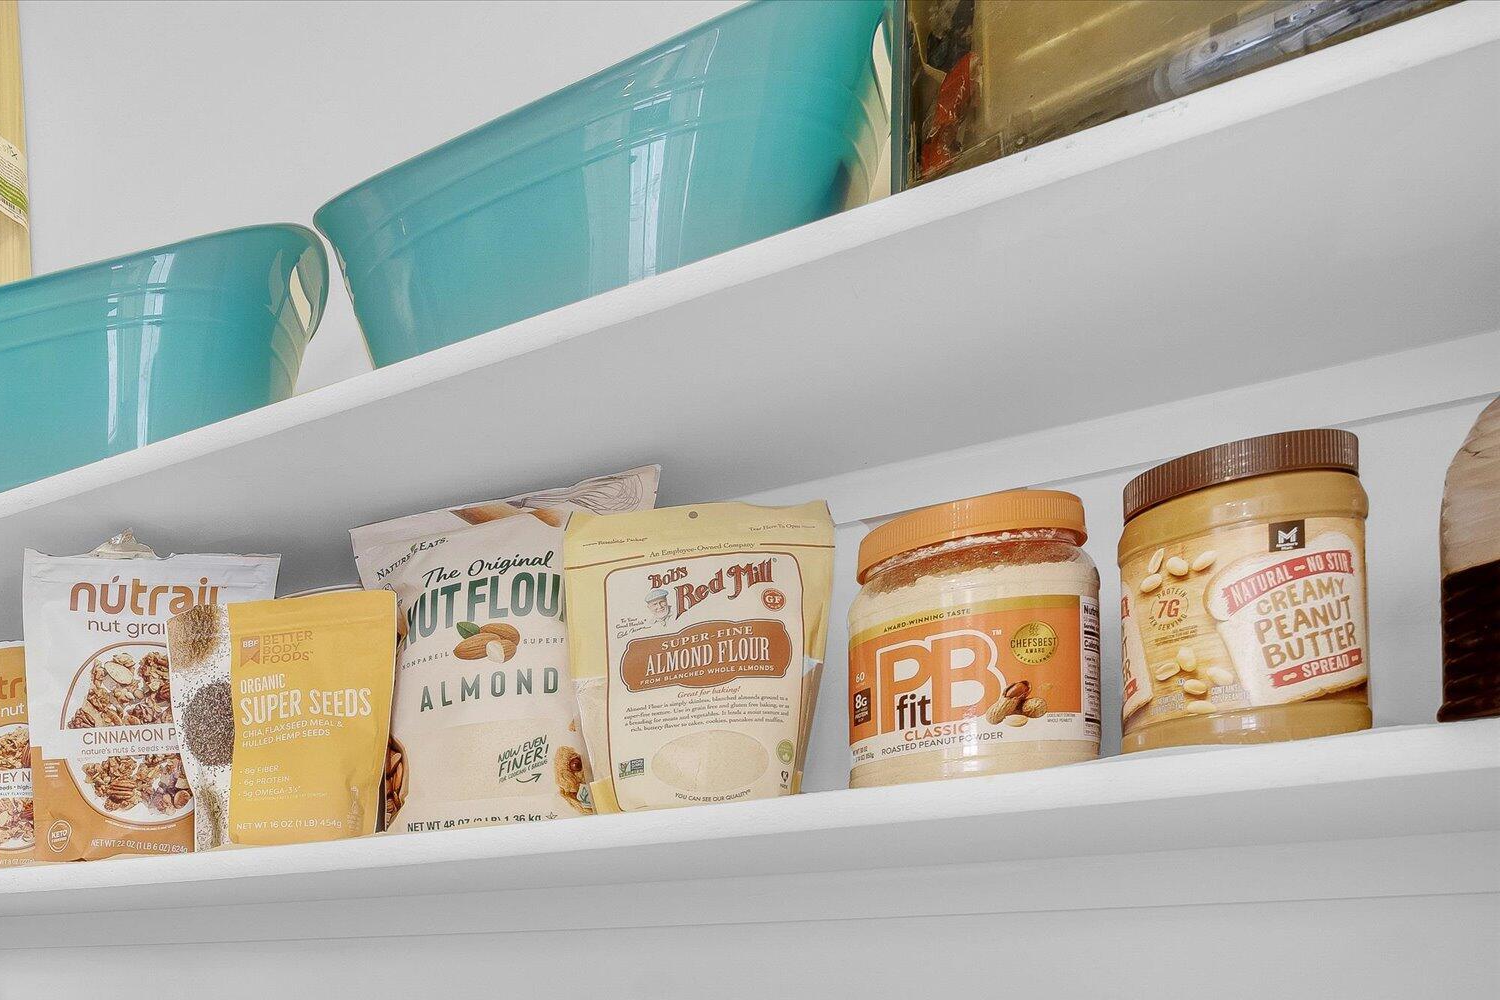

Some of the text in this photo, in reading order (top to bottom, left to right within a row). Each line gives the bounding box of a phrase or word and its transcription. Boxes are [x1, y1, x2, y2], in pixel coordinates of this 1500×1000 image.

[724, 541, 755, 552] Company
[422, 551, 554, 588] The Original
[1231, 556, 1323, 606] NATURAL NO
[467, 572, 565, 623] FLOU
[648, 557, 774, 621] Bob's Red Mill
[1256, 577, 1345, 616] CREAMY
[883, 607, 971, 633] AWARD-WINNING TASTE
[1157, 599, 1180, 619] 7G
[1254, 595, 1351, 645] PEANUT
[87, 619, 121, 633] nut
[263, 630, 313, 646] BETTER
[661, 624, 754, 651] SUPER-FINE
[242, 638, 260, 648] BBF
[263, 642, 299, 654] BODY
[1010, 637, 1058, 649] CHEFSBEST
[1261, 621, 1357, 669] BUTTER
[262, 651, 310, 665] FOODS
[645, 637, 770, 677] ALMOND FLOUR
[1302, 653, 1350, 678] SPREAD
[240, 673, 285, 693] ORGANIC
[639, 664, 775, 687] FROM BLANCHED WHOLE ALMONDS
[876, 630, 1008, 735] PB
[420, 667, 559, 713] ALMOND
[677, 688, 697, 699] Great
[0, 704, 24, 717] nut
[240, 687, 372, 727] SUPER SEEDS
[896, 693, 931, 731] fit
[83, 729, 164, 746] CINNAMON
[242, 732, 300, 748] HULLED HEMP
[265, 719, 335, 737] FLAXSEED MEAL
[904, 723, 970, 742] CLASSIC
[81, 744, 159, 756] nature's nuts seeds
[881, 731, 1003, 756] ROASTED PEANUT POWDER
[498, 743, 550, 778] FINER!
